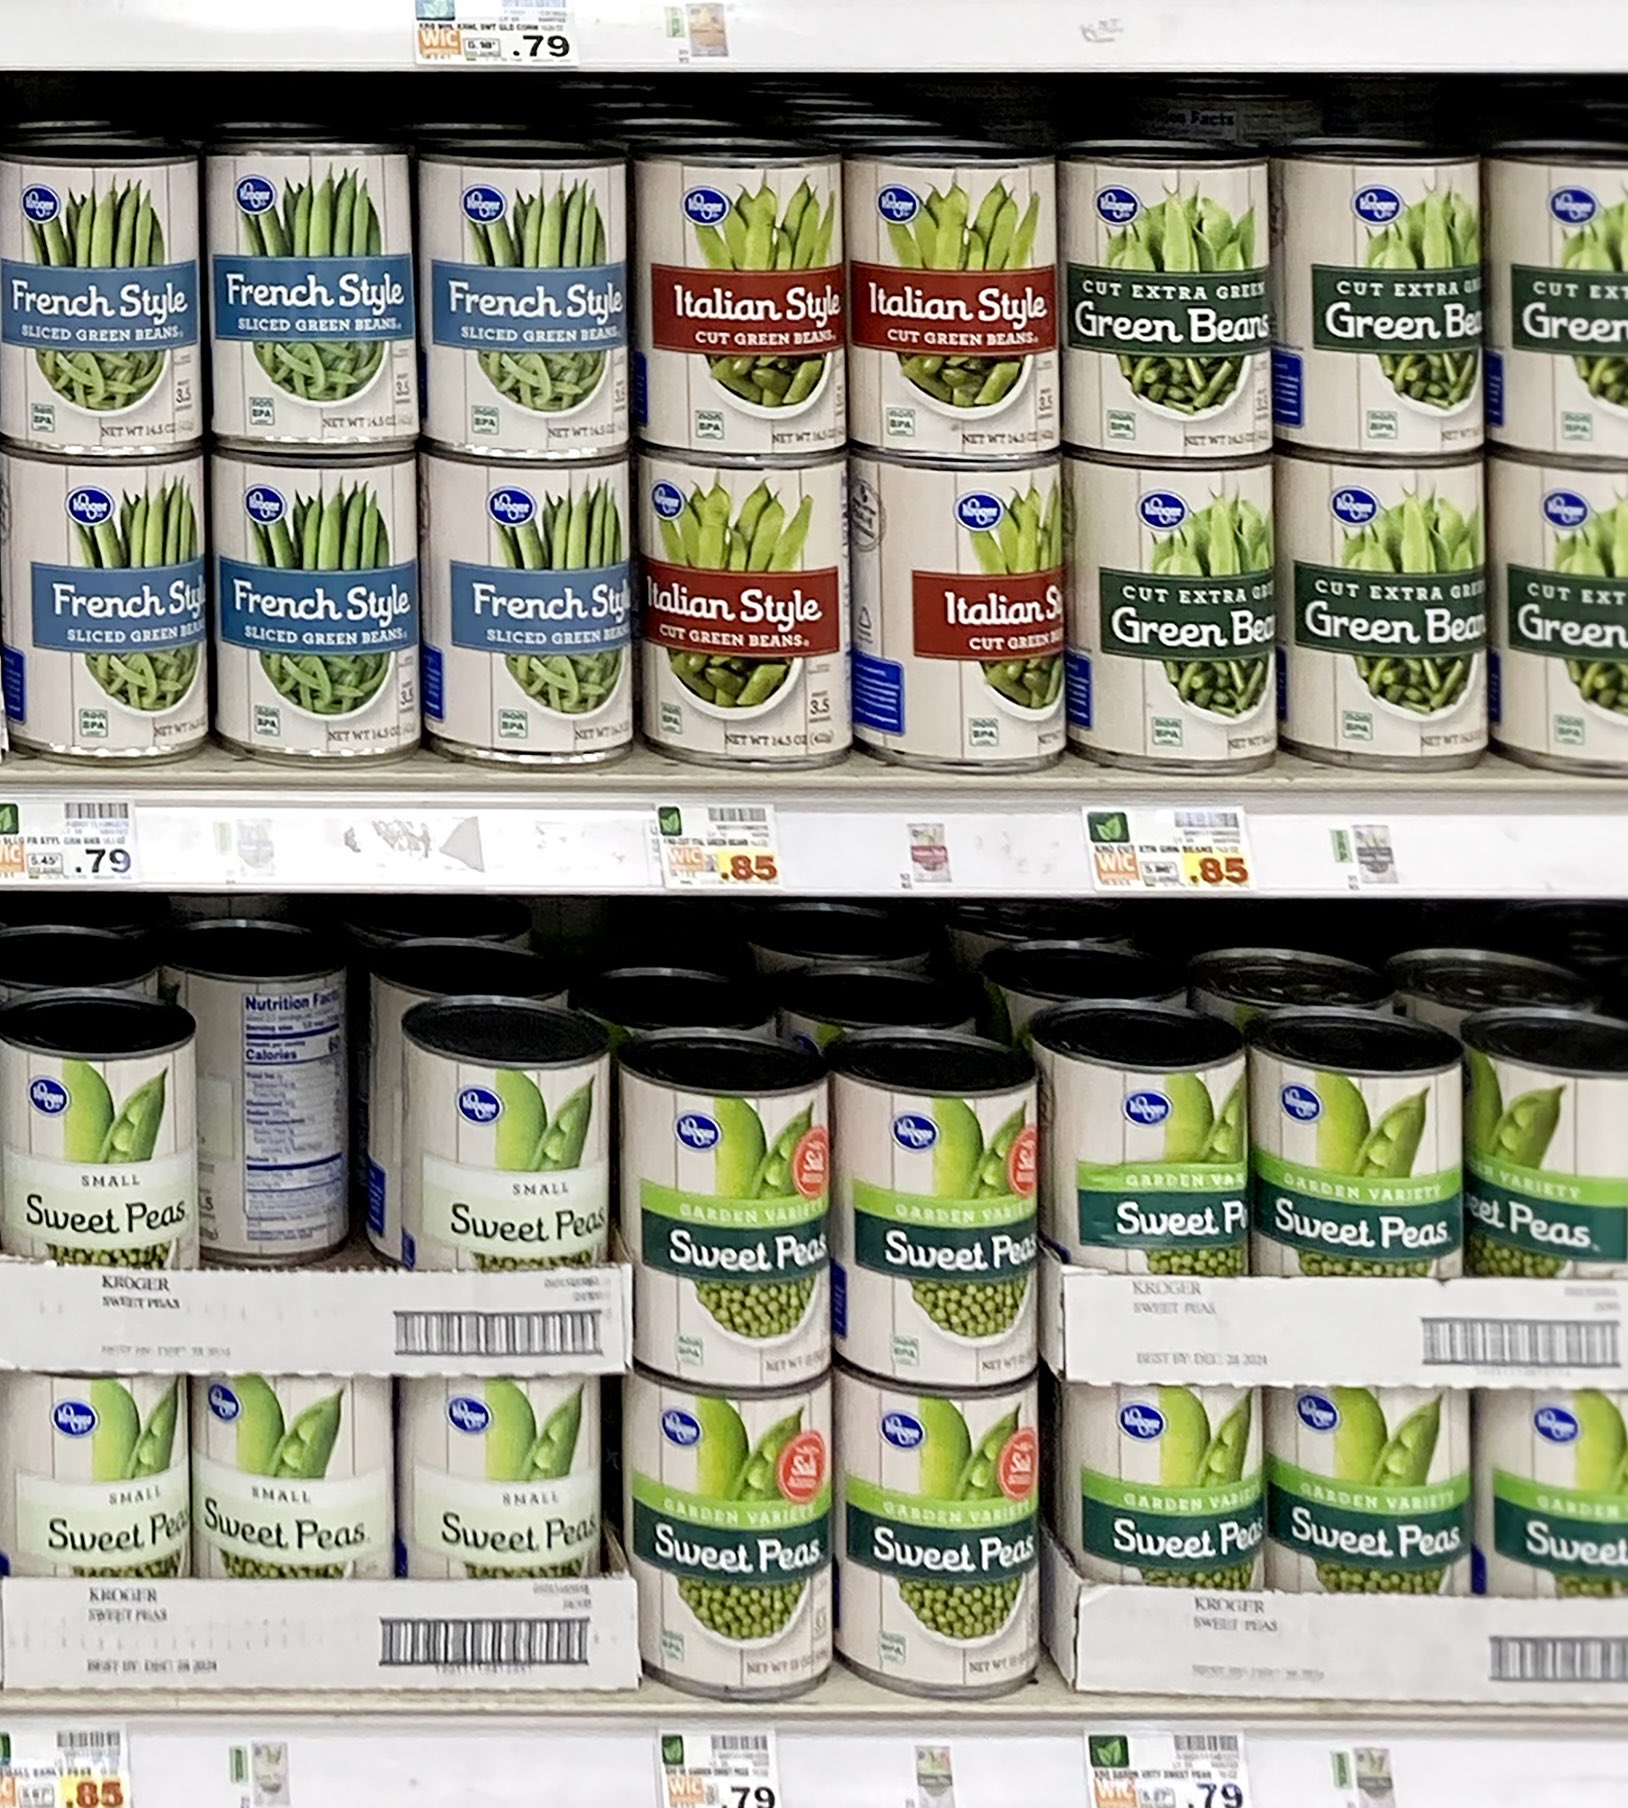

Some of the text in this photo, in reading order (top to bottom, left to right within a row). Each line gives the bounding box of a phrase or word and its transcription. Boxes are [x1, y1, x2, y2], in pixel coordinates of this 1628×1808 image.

[419, 30, 459, 47] WIC
[511, 34, 571, 58] .79
[11, 276, 188, 325] French Style
[226, 273, 405, 315] French Style
[1082, 280, 1266, 300] CUT EXTRA GREEN
[1335, 280, 1384, 298] CUT
[1393, 282, 1459, 298] EXTRA
[1532, 281, 1579, 299] CUT
[448, 280, 624, 325] French Style
[674, 284, 841, 328] Italian Style
[868, 282, 1047, 330] Italian Style
[238, 317, 396, 331] SLICED GREEN BEANS
[1074, 301, 1270, 344] Green Beans
[1325, 301, 1441, 340] Green
[1521, 302, 1628, 341] Green
[21, 324, 178, 342] SLICED GREEN BEANS
[461, 325, 618, 342] SLICED GREEN BEANS
[695, 328, 834, 345] CUT GREEN BEANS
[887, 329, 1035, 345] CUT GREEN BEANS
[52, 583, 165, 619] French
[233, 578, 411, 628] French Style
[472, 579, 630, 624] French Styl
[1122, 585, 1247, 605] CUT EXTRA
[1315, 580, 1443, 602] CUT EXTRA
[1526, 582, 1628, 604] CUT EXT
[647, 575, 823, 634] Italian Style
[944, 591, 1044, 625] Italian
[1111, 606, 1228, 647] Green
[1304, 600, 1420, 644] Green
[1517, 602, 1628, 648] Green
[67, 627, 178, 643] SLICED GREEN
[244, 625, 403, 645] SLICED GREEN BEANS
[486, 628, 601, 645] SLICED GREEN
[658, 624, 803, 648] CUT GREEN BEANS
[969, 635, 1049, 651] CUT GREEN
[809, 698, 830, 715] 3.5
[725, 734, 747, 746] NET
[749, 734, 770, 746] WT
[75, 848, 132, 873] .79
[721, 854, 778, 881] .85
[1095, 852, 1137, 872] WIC
[1189, 857, 1250, 884] .85
[246, 994, 309, 1012] Nutrition
[246, 1048, 298, 1061] Calories
[81, 1174, 141, 1188] SMALL
[512, 1182, 569, 1196] SMALL
[1126, 1173, 1204, 1187] GARDEN
[1284, 1172, 1441, 1202] GARDEN VARIETY
[1500, 1170, 1581, 1200] VARIETY
[26, 1193, 120, 1234] Sweet
[125, 1200, 186, 1234] Peas
[451, 1203, 605, 1242] Sweet Peas
[680, 1203, 758, 1224] GARDEN
[895, 1203, 974, 1225] GARDEN
[1116, 1201, 1219, 1237] Sweet
[1275, 1197, 1375, 1244] Sweet
[1379, 1215, 1448, 1249] Peas
[1509, 1200, 1591, 1249] Peas
[669, 1229, 827, 1272] Sweet Peas
[885, 1230, 988, 1272] Sweet
[102, 1275, 169, 1293] KROGER
[1132, 1281, 1201, 1297] KROGER
[109, 1484, 161, 1505] SMALL
[252, 1486, 311, 1504] SMALL
[502, 1491, 560, 1507] SMALL
[1123, 1491, 1204, 1513] GARDEN
[1300, 1481, 1455, 1511] GARDEN VARIETY
[664, 1497, 817, 1526] GARDEN VARIETY
[882, 1500, 961, 1524] GARDEN
[1537, 1495, 1619, 1519] GARDEN
[48, 1517, 145, 1552] Sweet
[204, 1497, 365, 1551] Sweet Peas
[441, 1511, 596, 1553] Sweet Peas
[1292, 1507, 1461, 1557] Sweet Peas
[654, 1523, 820, 1573] Sweet Peas
[874, 1526, 1036, 1571] Sweet Peas
[1113, 1517, 1263, 1559] Sweet Peas
[1526, 1520, 1628, 1566] Sweet
[89, 1587, 159, 1602] KROGER
[1194, 1597, 1265, 1614] KROGER
[66, 1781, 123, 1808] .85
[1095, 1779, 1135, 1800] WIC
